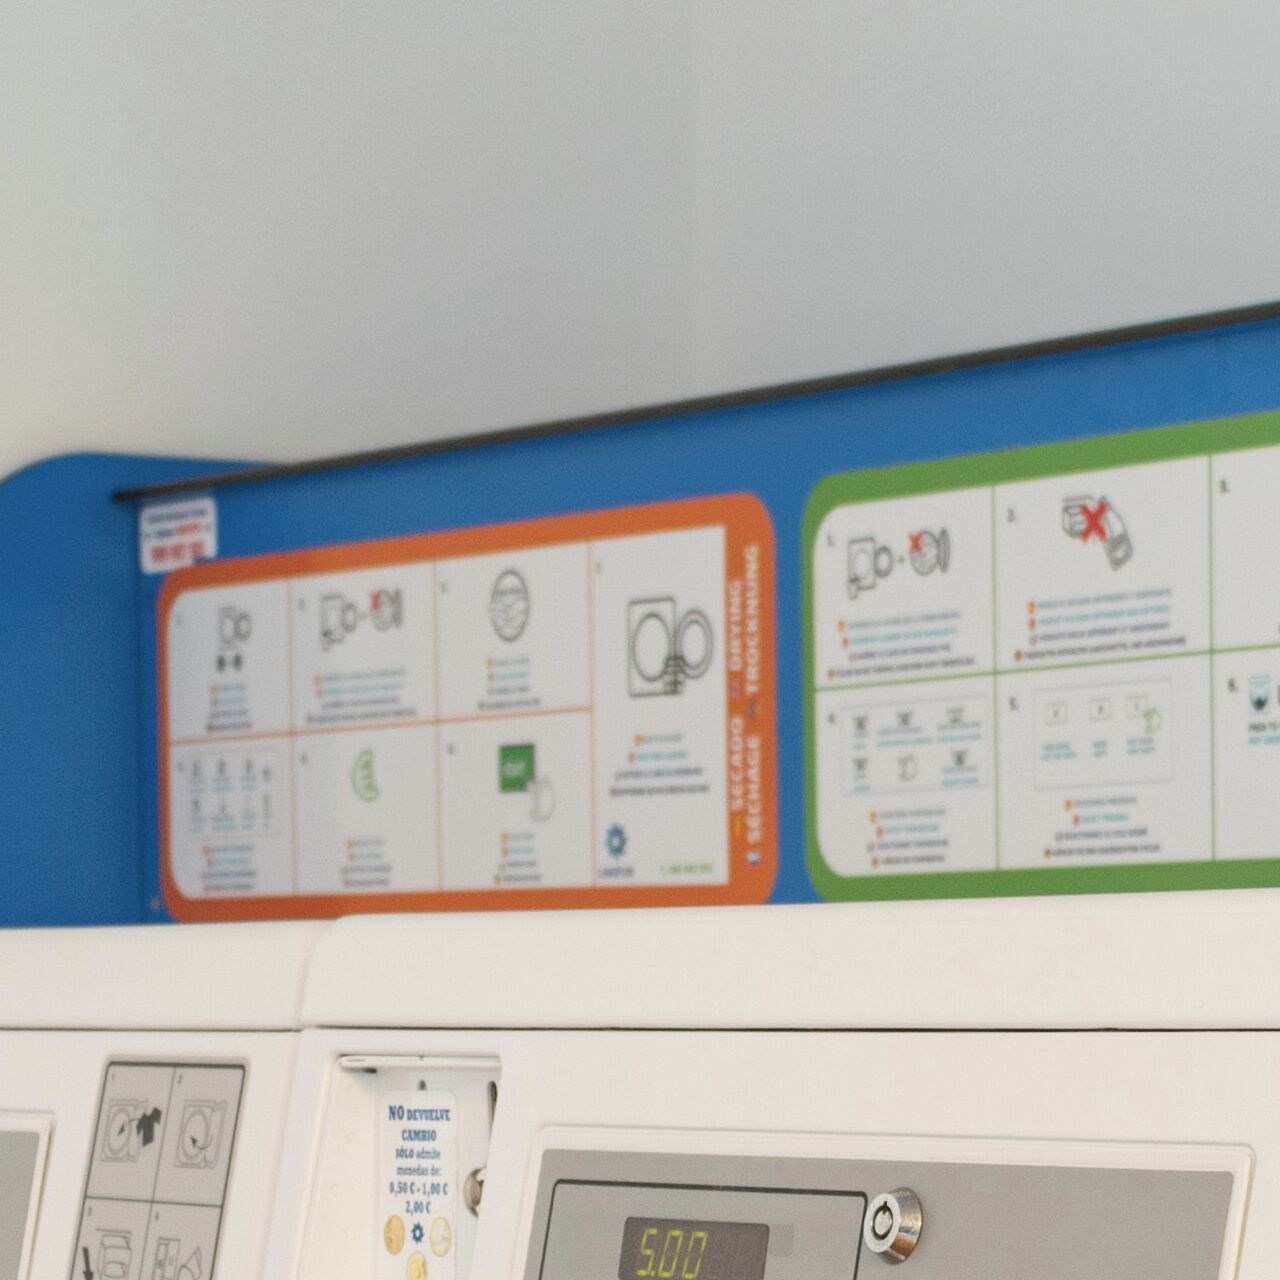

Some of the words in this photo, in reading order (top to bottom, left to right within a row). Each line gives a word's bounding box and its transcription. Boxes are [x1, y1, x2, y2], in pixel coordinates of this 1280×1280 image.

[388, 1105, 404, 1121] NO
[407, 1108, 451, 1121] DEVUELVE
[402, 1129, 436, 1142] CAMBIO
[395, 1147, 415, 1159] SÓLO
[416, 1149, 441, 1160] admite
[396, 1165, 429, 1176] monedas
[430, 1164, 442, 1176] de:
[389, 1182, 409, 1197] 0,50
[422, 1183, 441, 1196] 1,00
[406, 1201, 424, 1216] 2,00
[636, 1228, 708, 1280] 5.00
